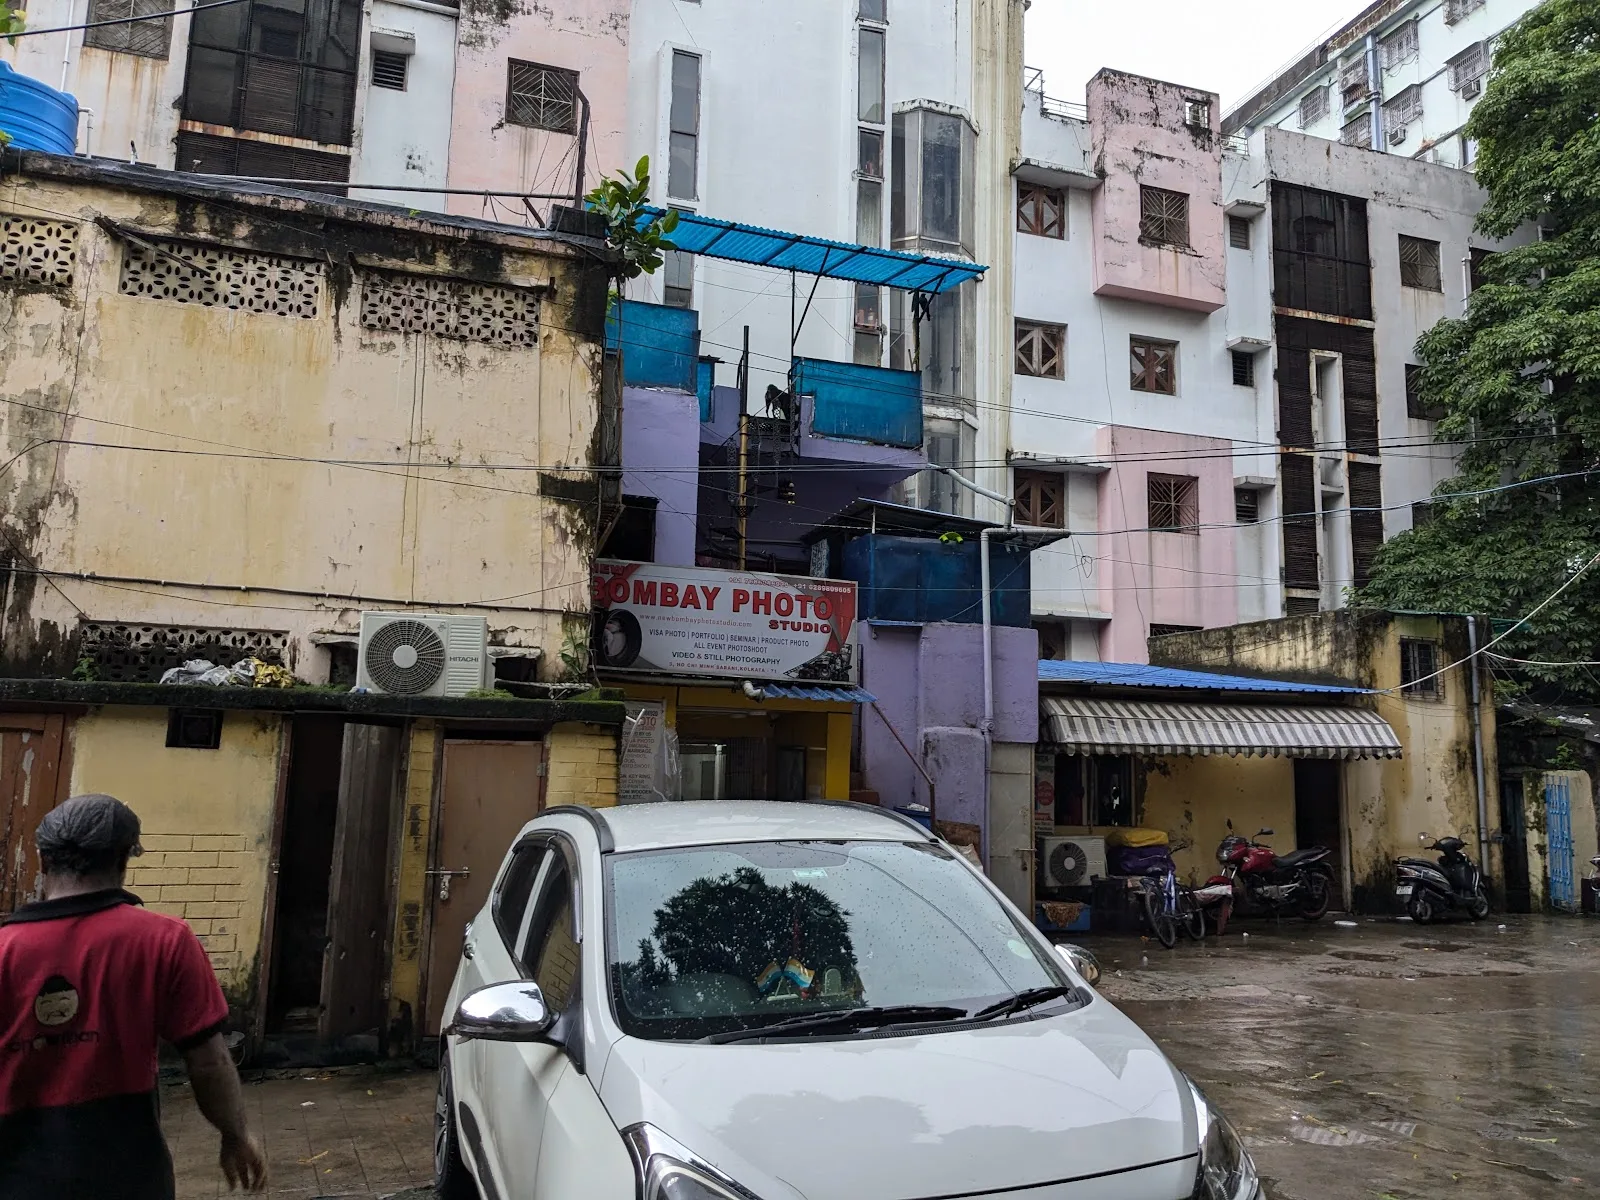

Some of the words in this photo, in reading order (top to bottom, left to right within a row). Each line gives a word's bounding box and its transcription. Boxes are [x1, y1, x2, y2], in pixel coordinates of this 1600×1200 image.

[592, 576, 721, 611] BOMBAY
[732, 588, 833, 620] PHOTO
[639, 614, 752, 628] www.newbombayphotostudio.com
[768, 619, 831, 634] STUDIO
[649, 628, 663, 637] VISA
[665, 629, 686, 638] PHOTO
[691, 631, 725, 641] PORTFOLIO
[730, 634, 756, 643] SEMINAR
[761, 637, 788, 646] PRODUCT
[790, 639, 809, 648] PHOTO
[694, 641, 705, 649] ALL
[707, 642, 726, 651] EVENT
[728, 644, 768, 654] PHOTOSHOOT
[672, 651, 695, 659] VIDEO
[697, 652, 702, 660] &
[704, 653, 723, 661] STILL
[725, 655, 780, 665] PHOTOGRAPHY
